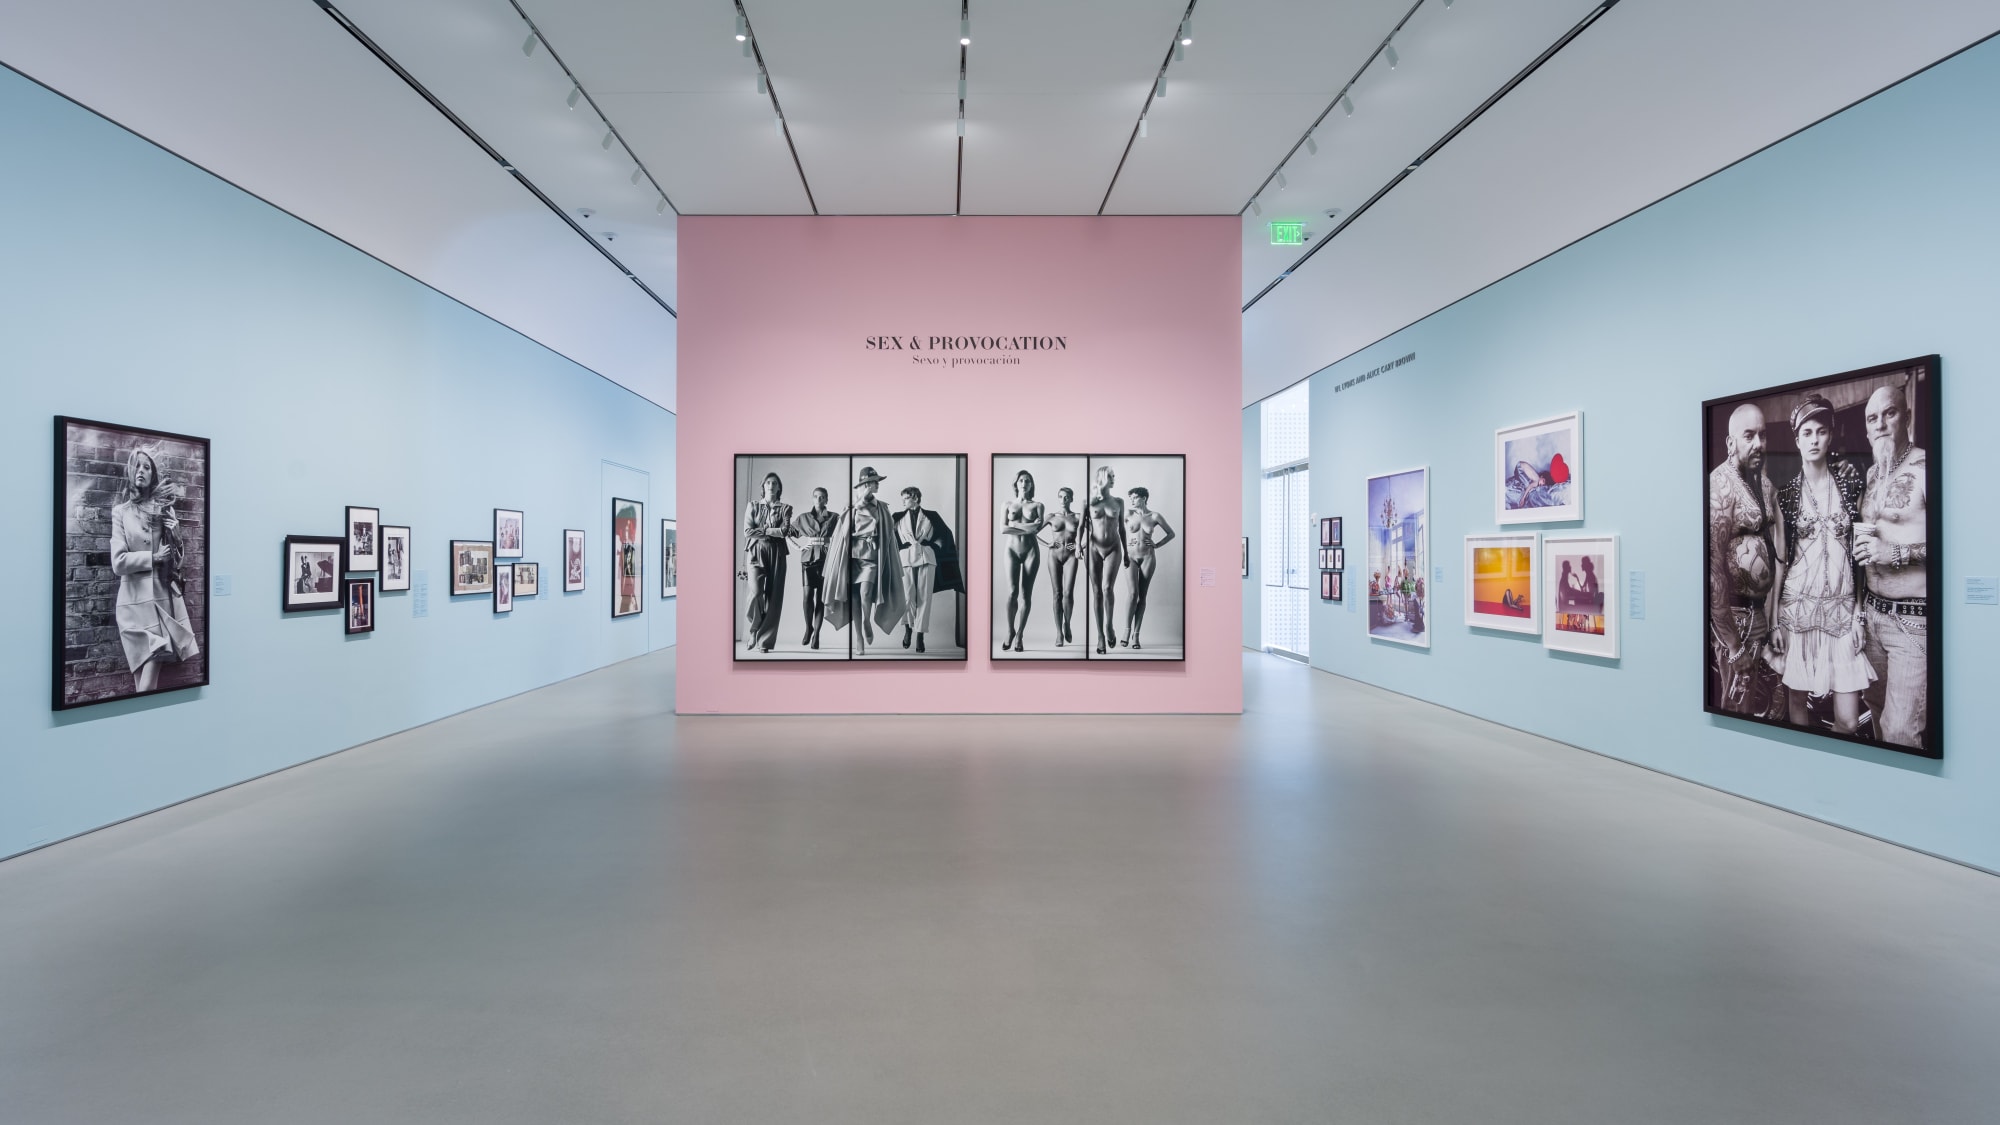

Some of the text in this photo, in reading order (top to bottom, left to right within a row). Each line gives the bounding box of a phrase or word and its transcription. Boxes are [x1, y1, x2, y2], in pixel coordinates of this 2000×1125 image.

[1277, 225, 1297, 242] EXIT
[865, 336, 1068, 350] SEX & PROVOCATION
[912, 354, 1021, 368] Sexo y provocación
[1355, 374, 1366, 384] AND
[1366, 368, 1380, 380] ALICE
[1395, 352, 1416, 367] BROWN
